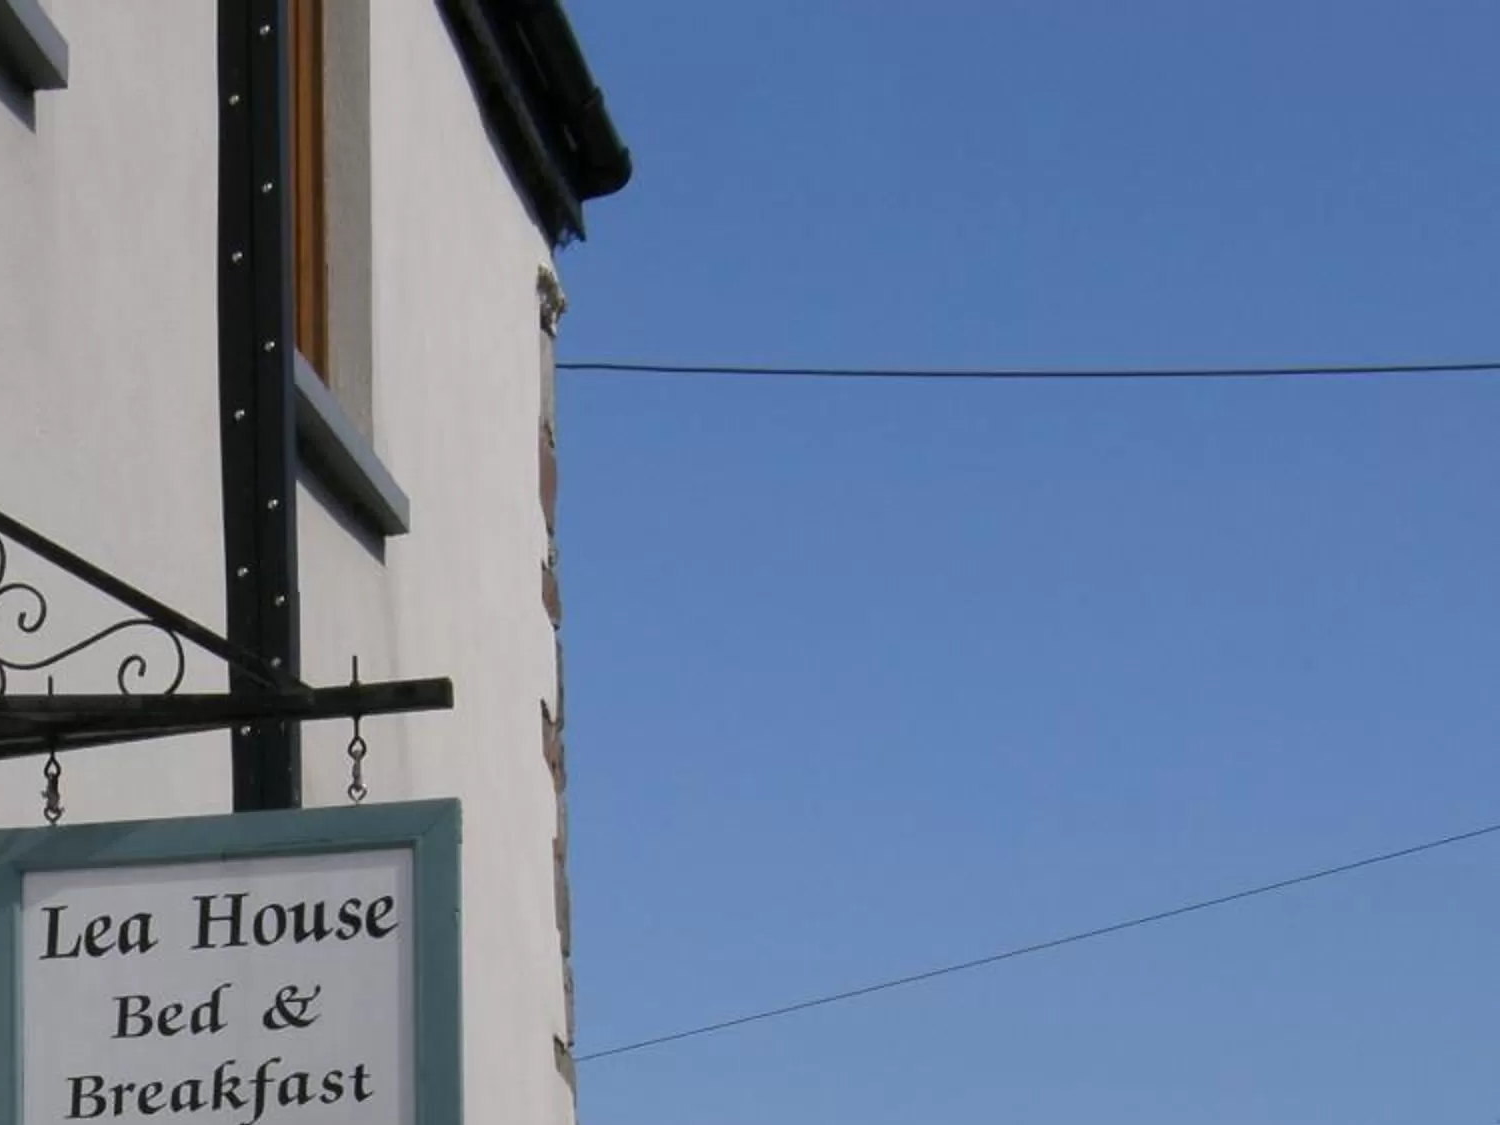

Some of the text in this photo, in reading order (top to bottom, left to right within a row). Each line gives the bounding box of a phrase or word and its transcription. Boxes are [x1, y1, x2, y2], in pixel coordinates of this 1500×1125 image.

[39, 892, 401, 961] Lea House
[111, 982, 322, 1039] Bed &
